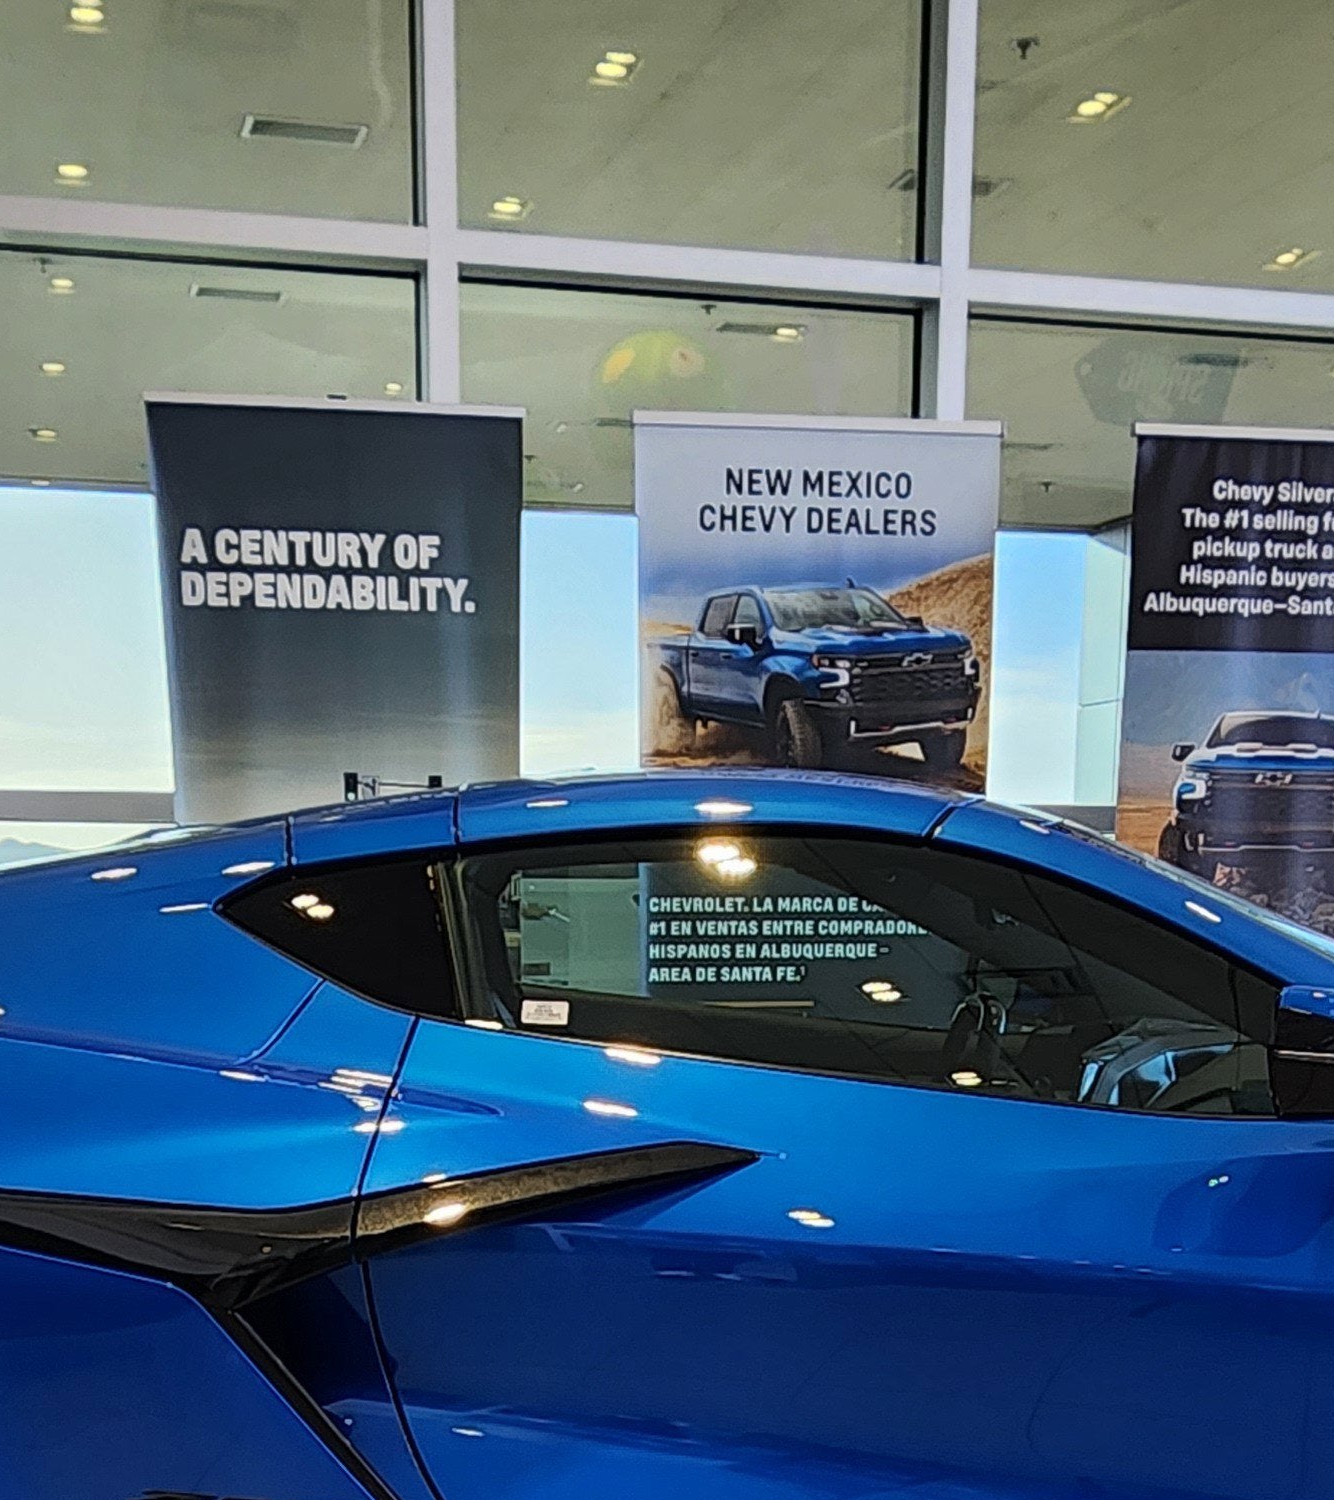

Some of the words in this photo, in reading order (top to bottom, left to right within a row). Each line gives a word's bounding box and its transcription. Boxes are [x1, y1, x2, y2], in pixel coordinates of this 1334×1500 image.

[725, 467, 791, 496] NEW
[802, 469, 912, 499] MEXICO
[1213, 479, 1274, 505] Chevy
[699, 504, 797, 534] CHEVY
[806, 506, 937, 537] DEALERS
[1181, 508, 1219, 528] The
[1224, 509, 1249, 528] #1
[1252, 511, 1319, 534] selling
[181, 528, 208, 564] A
[215, 528, 386, 568] CENTURY
[394, 534, 441, 570] OF
[1192, 535, 1260, 561] pickup
[1264, 538, 1318, 559] truck
[1180, 564, 1267, 588] Hispanic
[181, 571, 476, 613] DEPENDABILITY.
[649, 897, 749, 912] CHEVROLET.
[753, 897, 773, 912] LA
[777, 897, 834, 912] MARCA
[837, 897, 859, 912] DE
[649, 920, 667, 936] #1
[671, 920, 692, 936] EN
[696, 920, 759, 936] VENTAS
[762, 920, 815, 936] ENTRE
[818, 920, 930, 936] COMPRADOR
[649, 943, 730, 959] HISPANOS
[735, 943, 757, 959] EN
[649, 966, 692, 982] AREA
[696, 966, 716, 982] DE
[720, 966, 774, 982] SANTA
